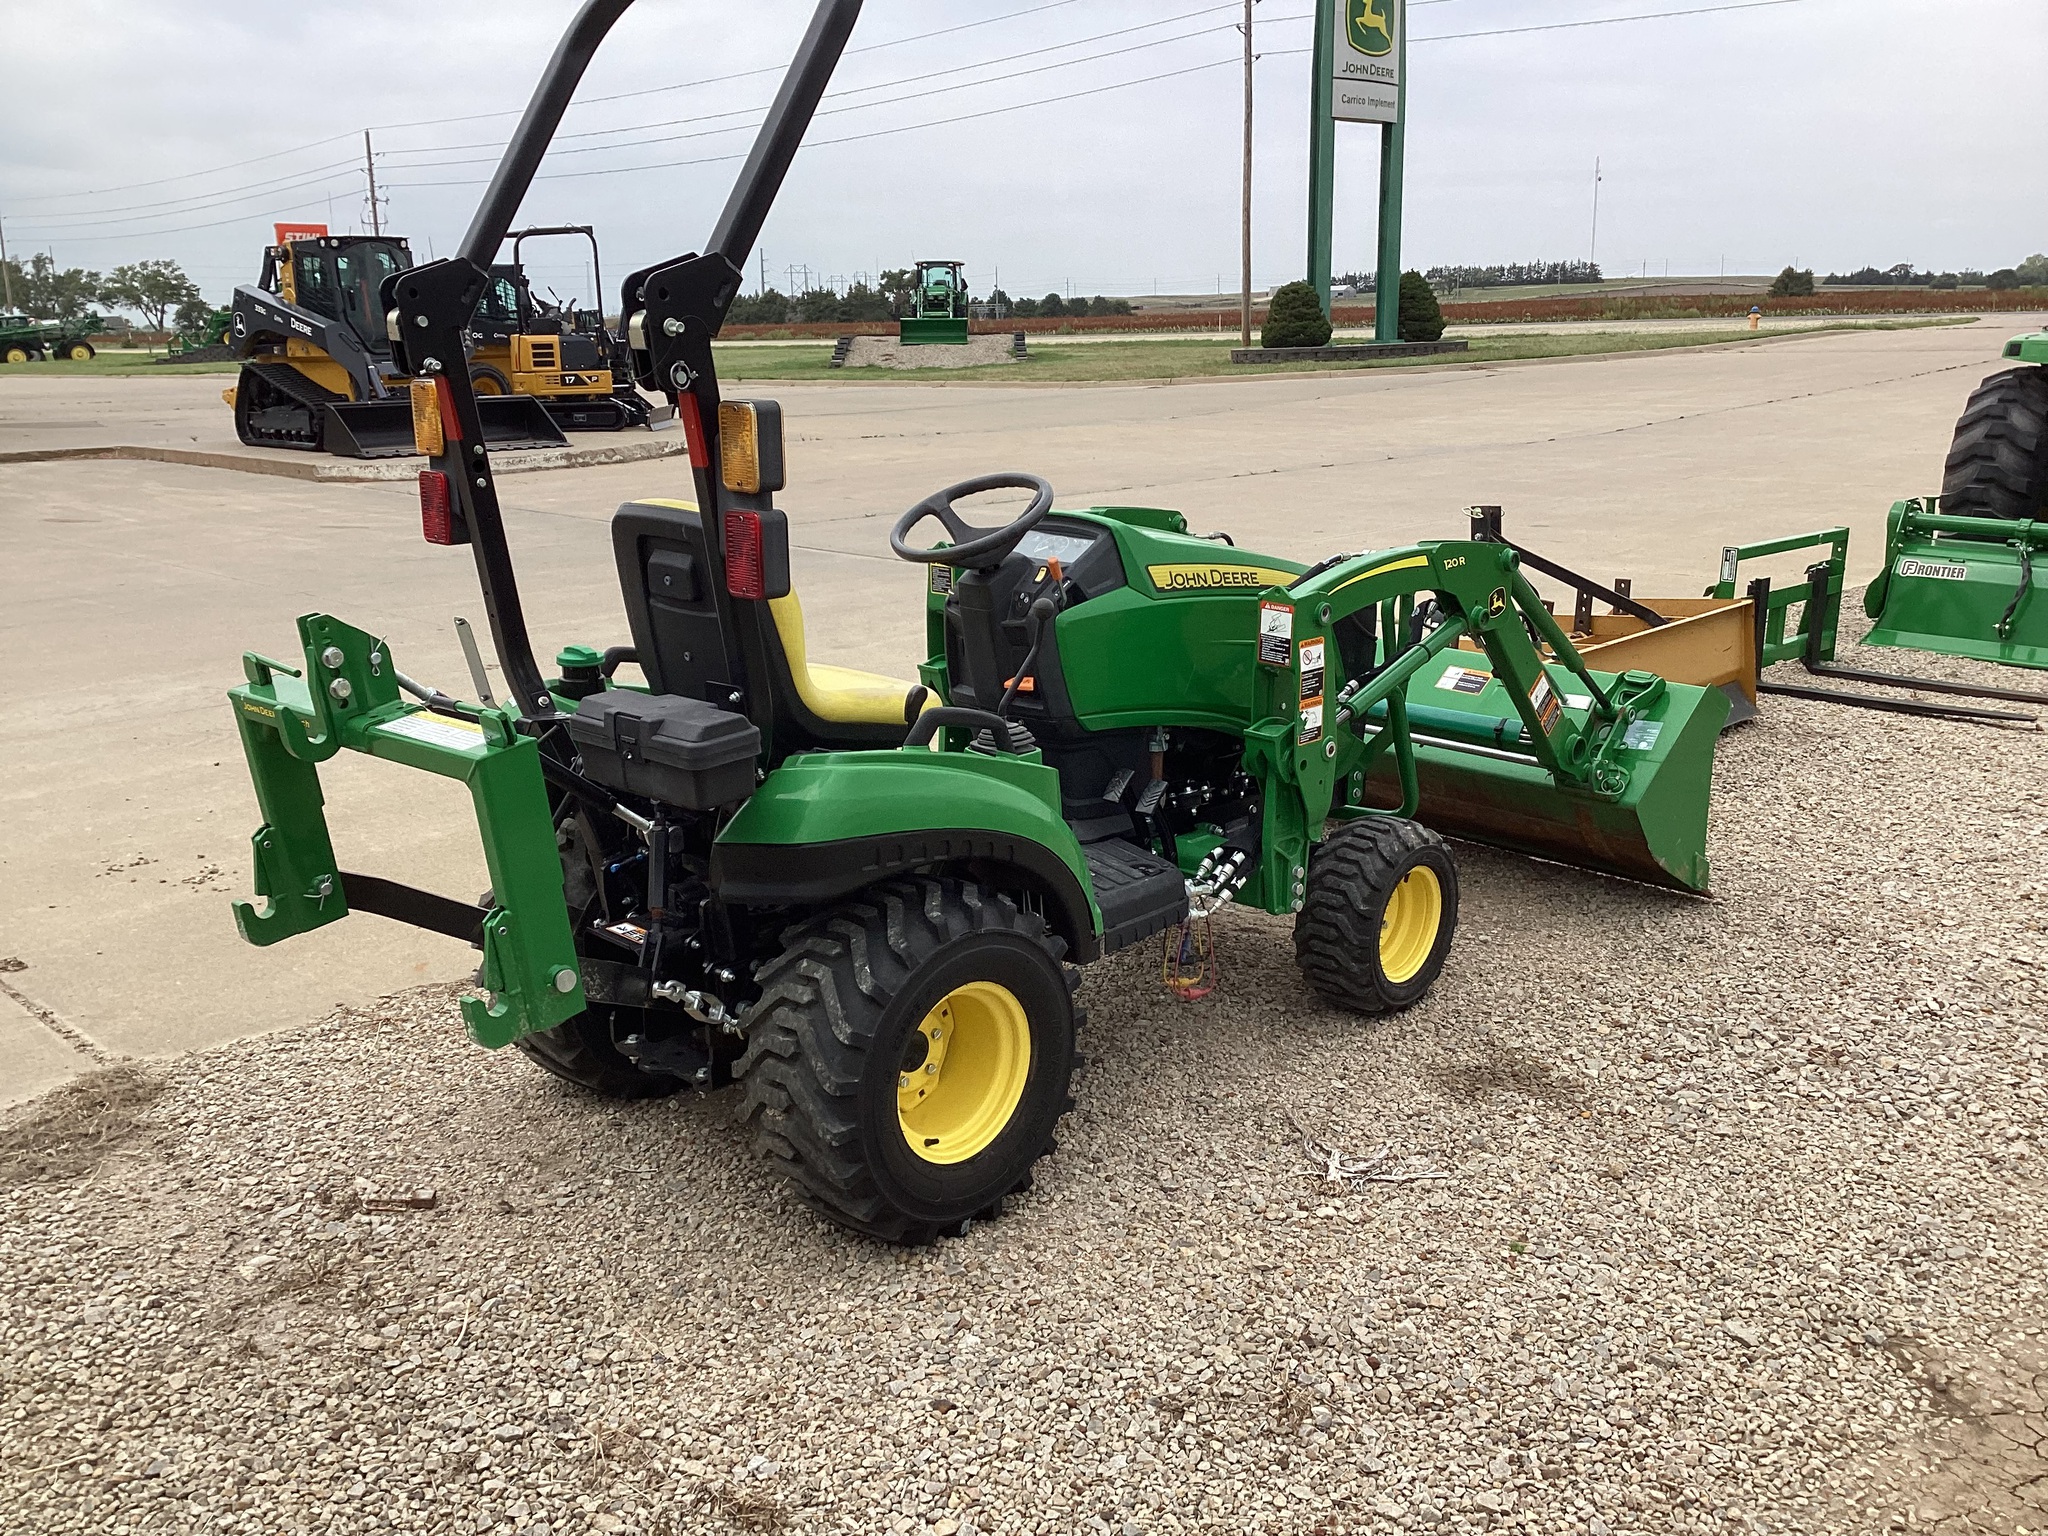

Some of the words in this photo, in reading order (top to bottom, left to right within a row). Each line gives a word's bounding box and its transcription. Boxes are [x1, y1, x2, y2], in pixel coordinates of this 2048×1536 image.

[1342, 61, 1369, 75] JOHN
[1369, 64, 1394, 79] DEERE
[1341, 93, 1366, 105] Carrico
[1367, 96, 1396, 109] Implement
[290, 317, 313, 337] DEERE
[565, 376, 576, 384] 17
[1901, 560, 1966, 579] FRONTIER
[1165, 570, 1208, 588] JOHN
[1209, 569, 1260, 586] DEERE
[1270, 604, 1290, 613] DANGER
[243, 701, 261, 714] JOHN
